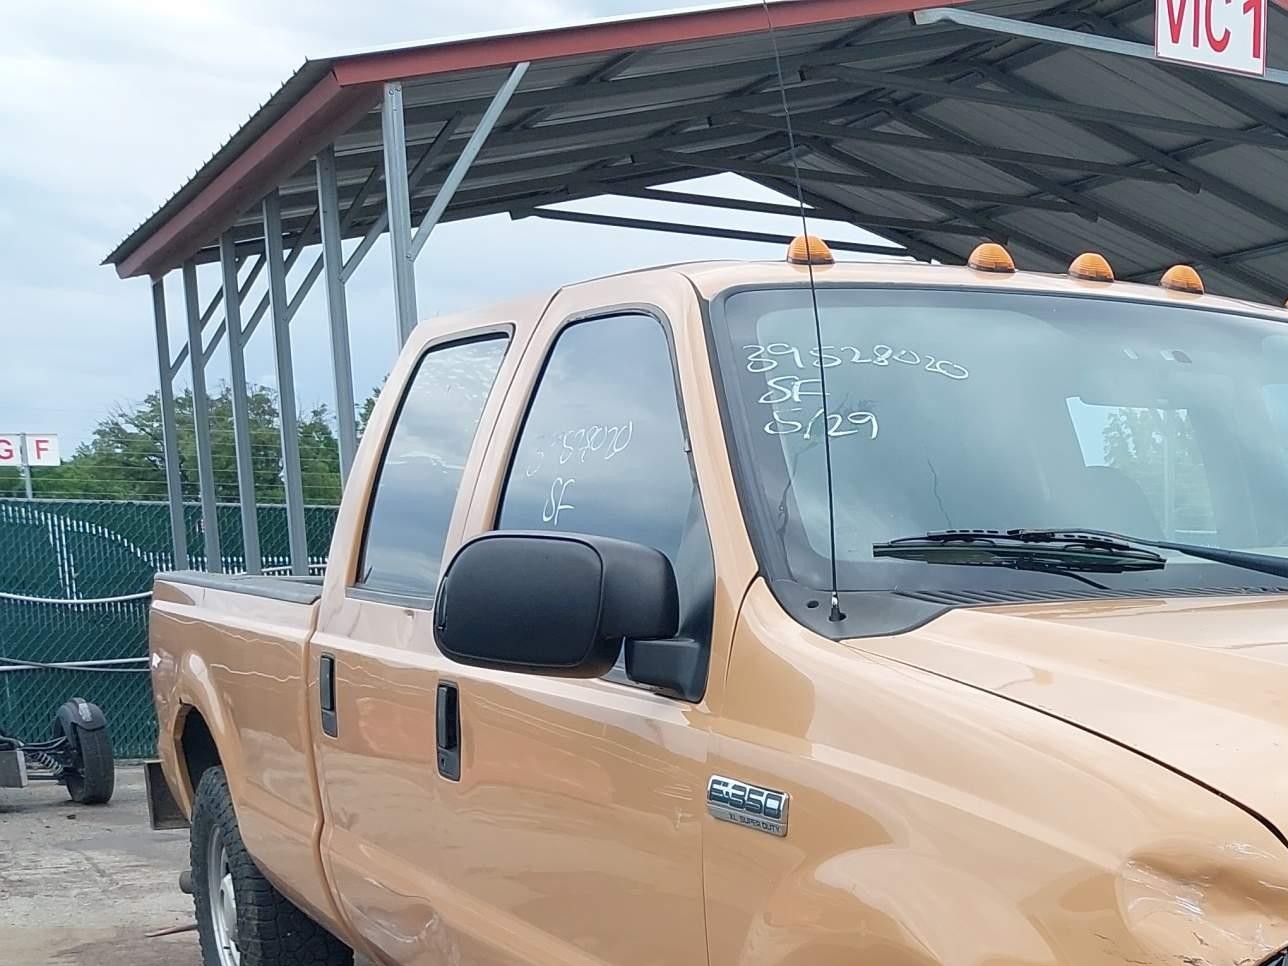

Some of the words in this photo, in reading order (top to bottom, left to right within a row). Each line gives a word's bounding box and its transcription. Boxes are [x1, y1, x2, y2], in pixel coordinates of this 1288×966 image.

[1167, 0, 1231, 53] VIC
[1243, 0, 1262, 59] 1
[743, 343, 969, 379] 39528020
[758, 376, 831, 404] SF
[764, 407, 879, 439] 5/29
[35, 439, 49, 460] F
